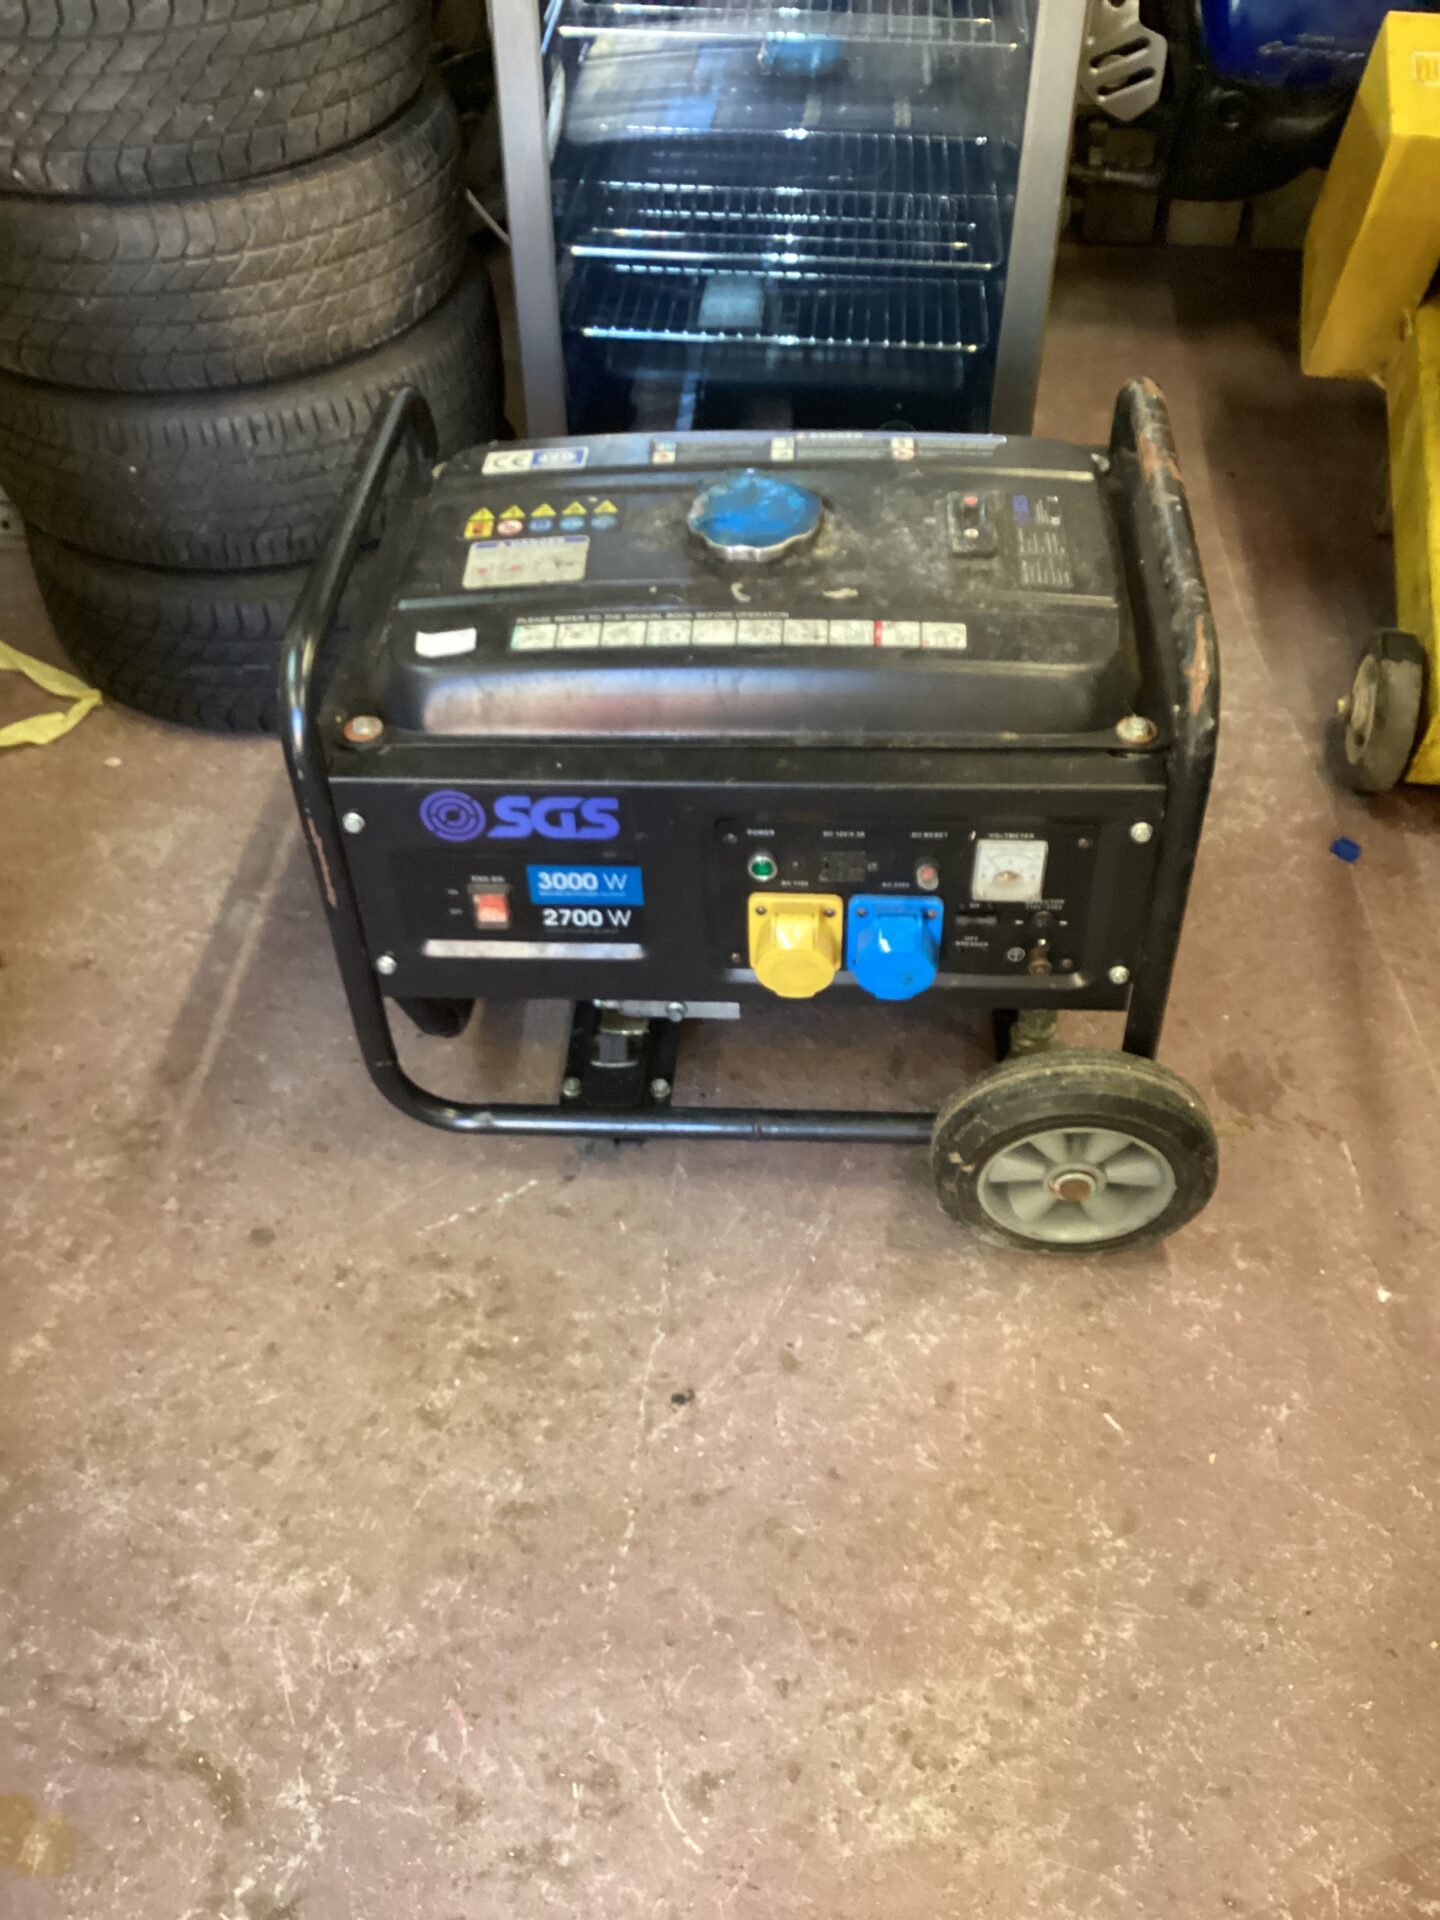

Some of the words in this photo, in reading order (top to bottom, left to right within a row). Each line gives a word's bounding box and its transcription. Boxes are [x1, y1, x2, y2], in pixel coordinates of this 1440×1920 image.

[588, 614, 602, 622] TO
[486, 795, 621, 841] SGS
[538, 871, 599, 891] 3000
[603, 872, 628, 891] W
[543, 908, 603, 927] 2700
[607, 908, 632, 927] W
